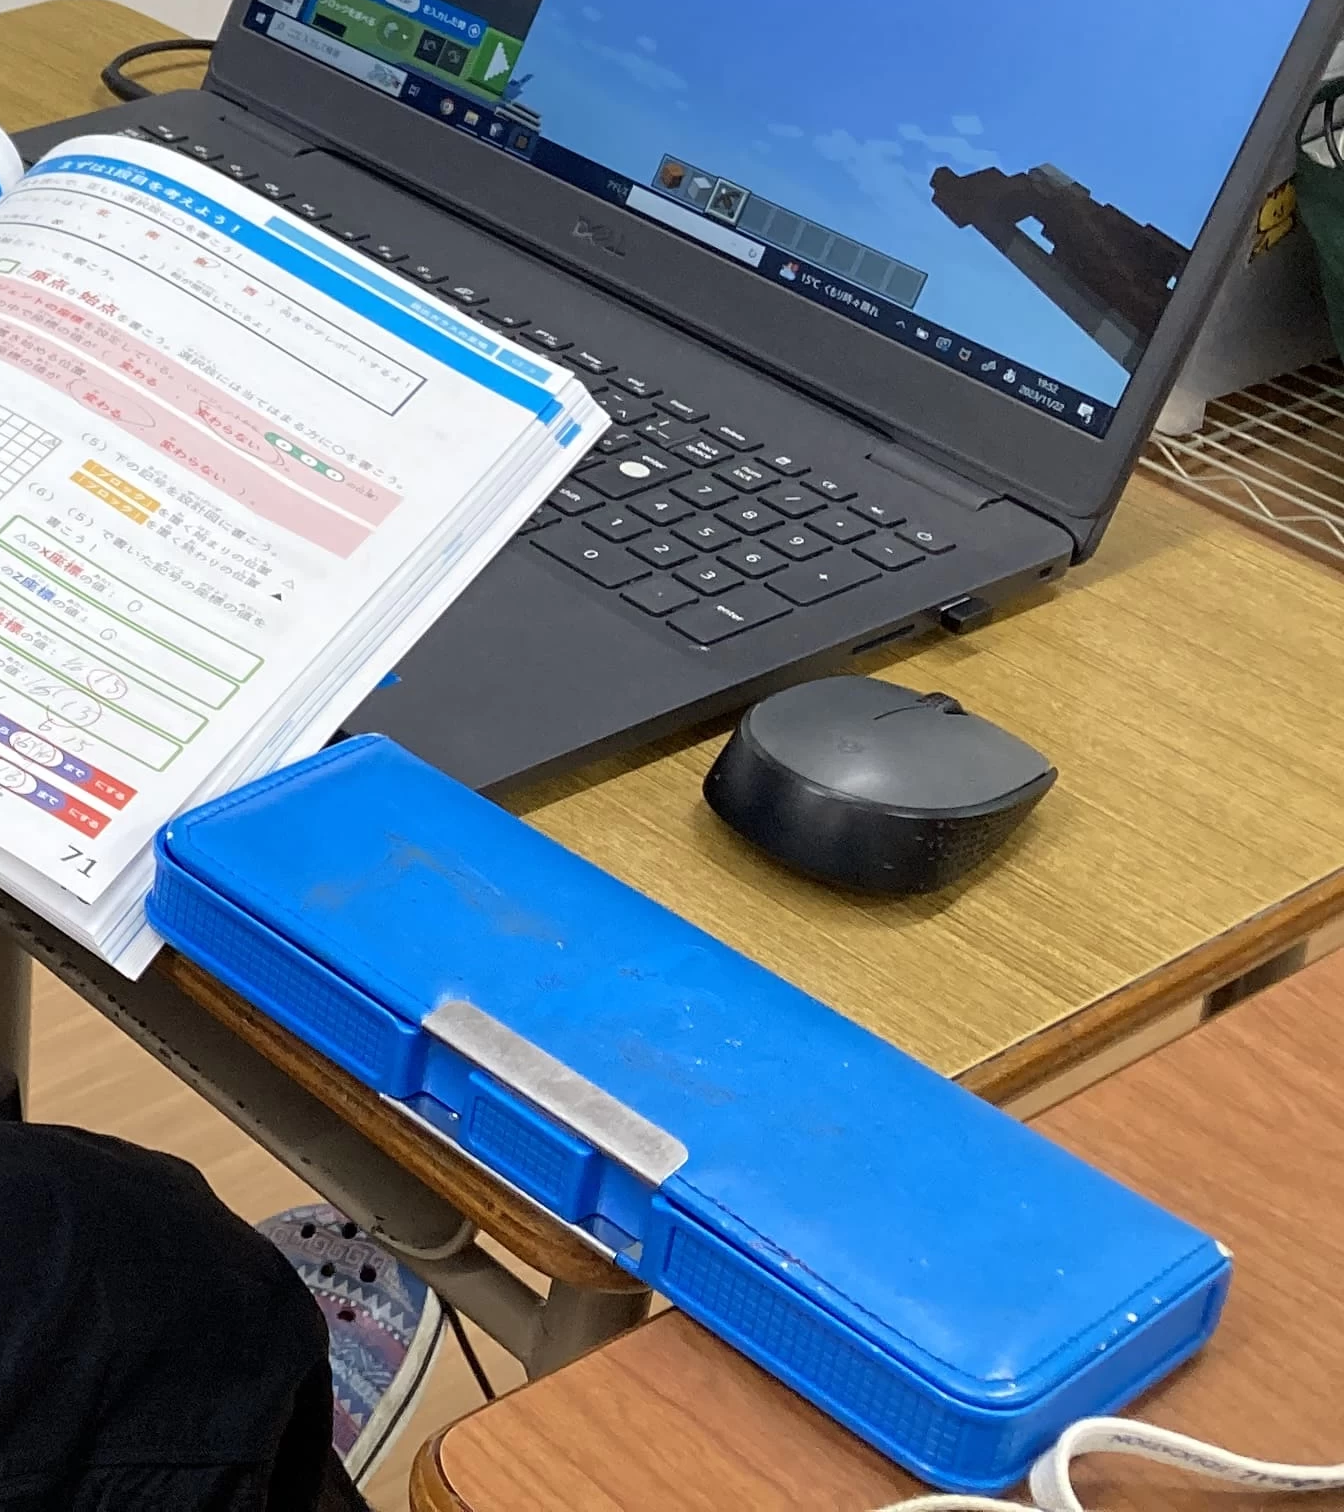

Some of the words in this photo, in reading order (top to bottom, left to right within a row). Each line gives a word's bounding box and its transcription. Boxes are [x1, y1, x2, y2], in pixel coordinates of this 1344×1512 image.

[422, 4, 466, 31] を入力した時
[58, 159, 242, 235] まずは1段目を考えよう!
[824, 284, 879, 318] くもり時々晴れ
[119, 360, 158, 387] 変わる
[194, 407, 261, 452] 変わらない
[81, 391, 122, 419] 変わる
[159, 439, 227, 485] 変わらない
[685, 444, 713, 460] space
[697, 441, 719, 456] back
[642, 454, 669, 470] enter
[559, 488, 581, 502] shift
[697, 485, 713, 494] 7
[115, 451, 279, 558] 下の記号を設計図に書こう。
[653, 501, 668, 512] 4
[611, 517, 624, 526] 1
[742, 509, 758, 521] 8
[46, 515, 98, 553] 書こう!
[698, 526, 715, 538] 5
[158, 507, 273, 577] を置く始まりの位置
[654, 543, 670, 555] 2
[788, 536, 805, 546] 9
[146, 520, 261, 588] を置く終わりの位置
[583, 549, 600, 560] 0
[746, 553, 762, 564] 6
[102, 528, 267, 629] で書いた記号の座標の値を
[700, 570, 717, 581] 3
[716, 604, 745, 622] enter
[63, 762, 86, 779] まで
[94, 779, 126, 802] にする
[36, 790, 60, 806] まで
[68, 807, 100, 830] にする
[58, 844, 99, 878] 71
